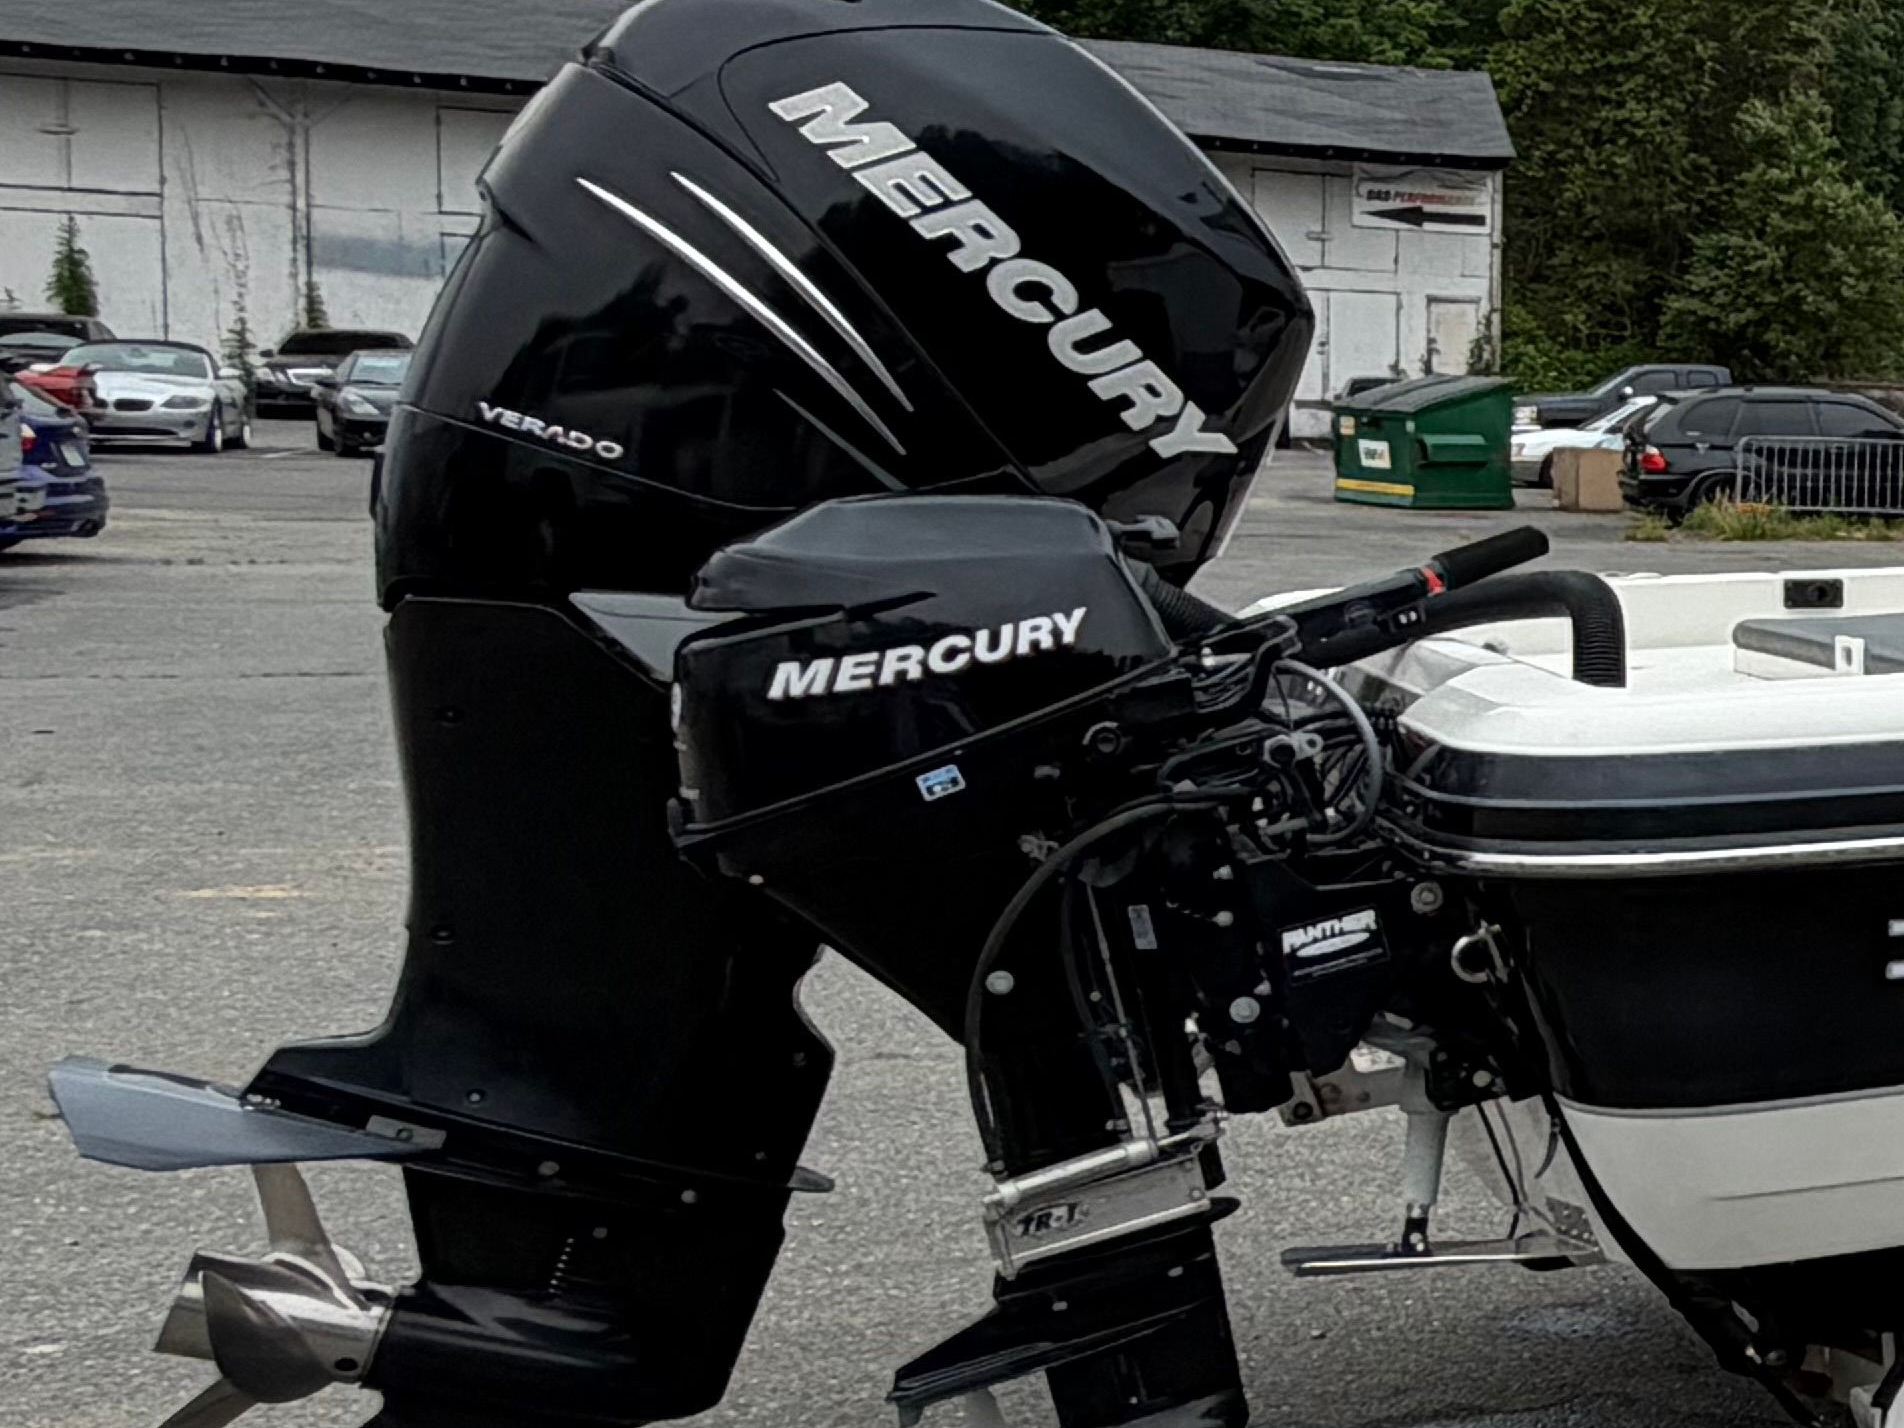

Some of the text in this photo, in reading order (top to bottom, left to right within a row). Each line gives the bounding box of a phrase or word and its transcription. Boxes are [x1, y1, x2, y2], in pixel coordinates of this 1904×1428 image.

[767, 80, 1239, 459] MERCURY
[477, 400, 625, 460] VERADO
[766, 606, 1088, 701] MERCURY
[1281, 908, 1378, 954] PANTHER
